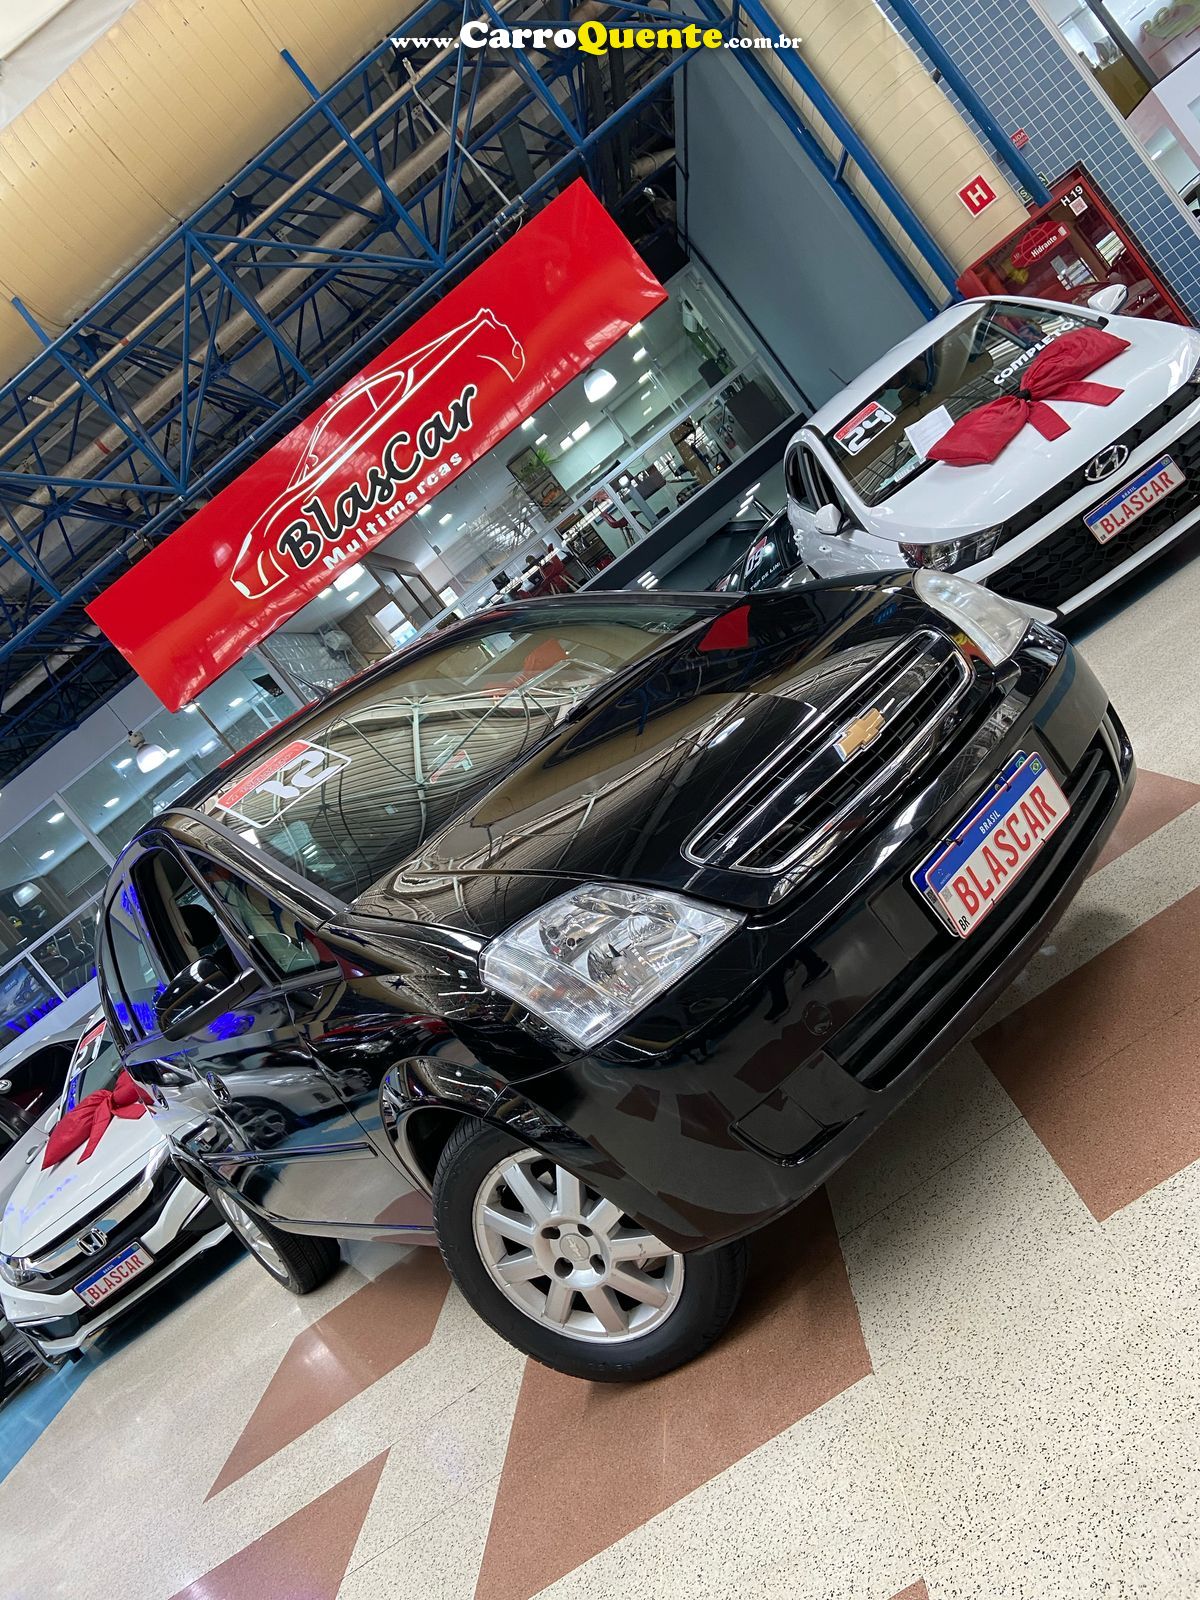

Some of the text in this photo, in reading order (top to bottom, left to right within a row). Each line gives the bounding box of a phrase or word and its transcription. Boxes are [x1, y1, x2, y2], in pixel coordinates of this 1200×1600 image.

[966, 184, 988, 207] H
[1060, 185, 1084, 207] H 19
[1030, 234, 1058, 258] Hidrante
[843, 409, 893, 452] 24
[277, 384, 478, 569] BlasCar
[322, 452, 464, 570] Multimarcas
[1099, 471, 1175, 535] BLASCAR
[255, 750, 344, 799] 12
[979, 810, 1001, 835] BRASIL
[952, 785, 1057, 917] BLASCAR
[958, 915, 971, 931] BR
[87, 1254, 144, 1300] BLASCAR
